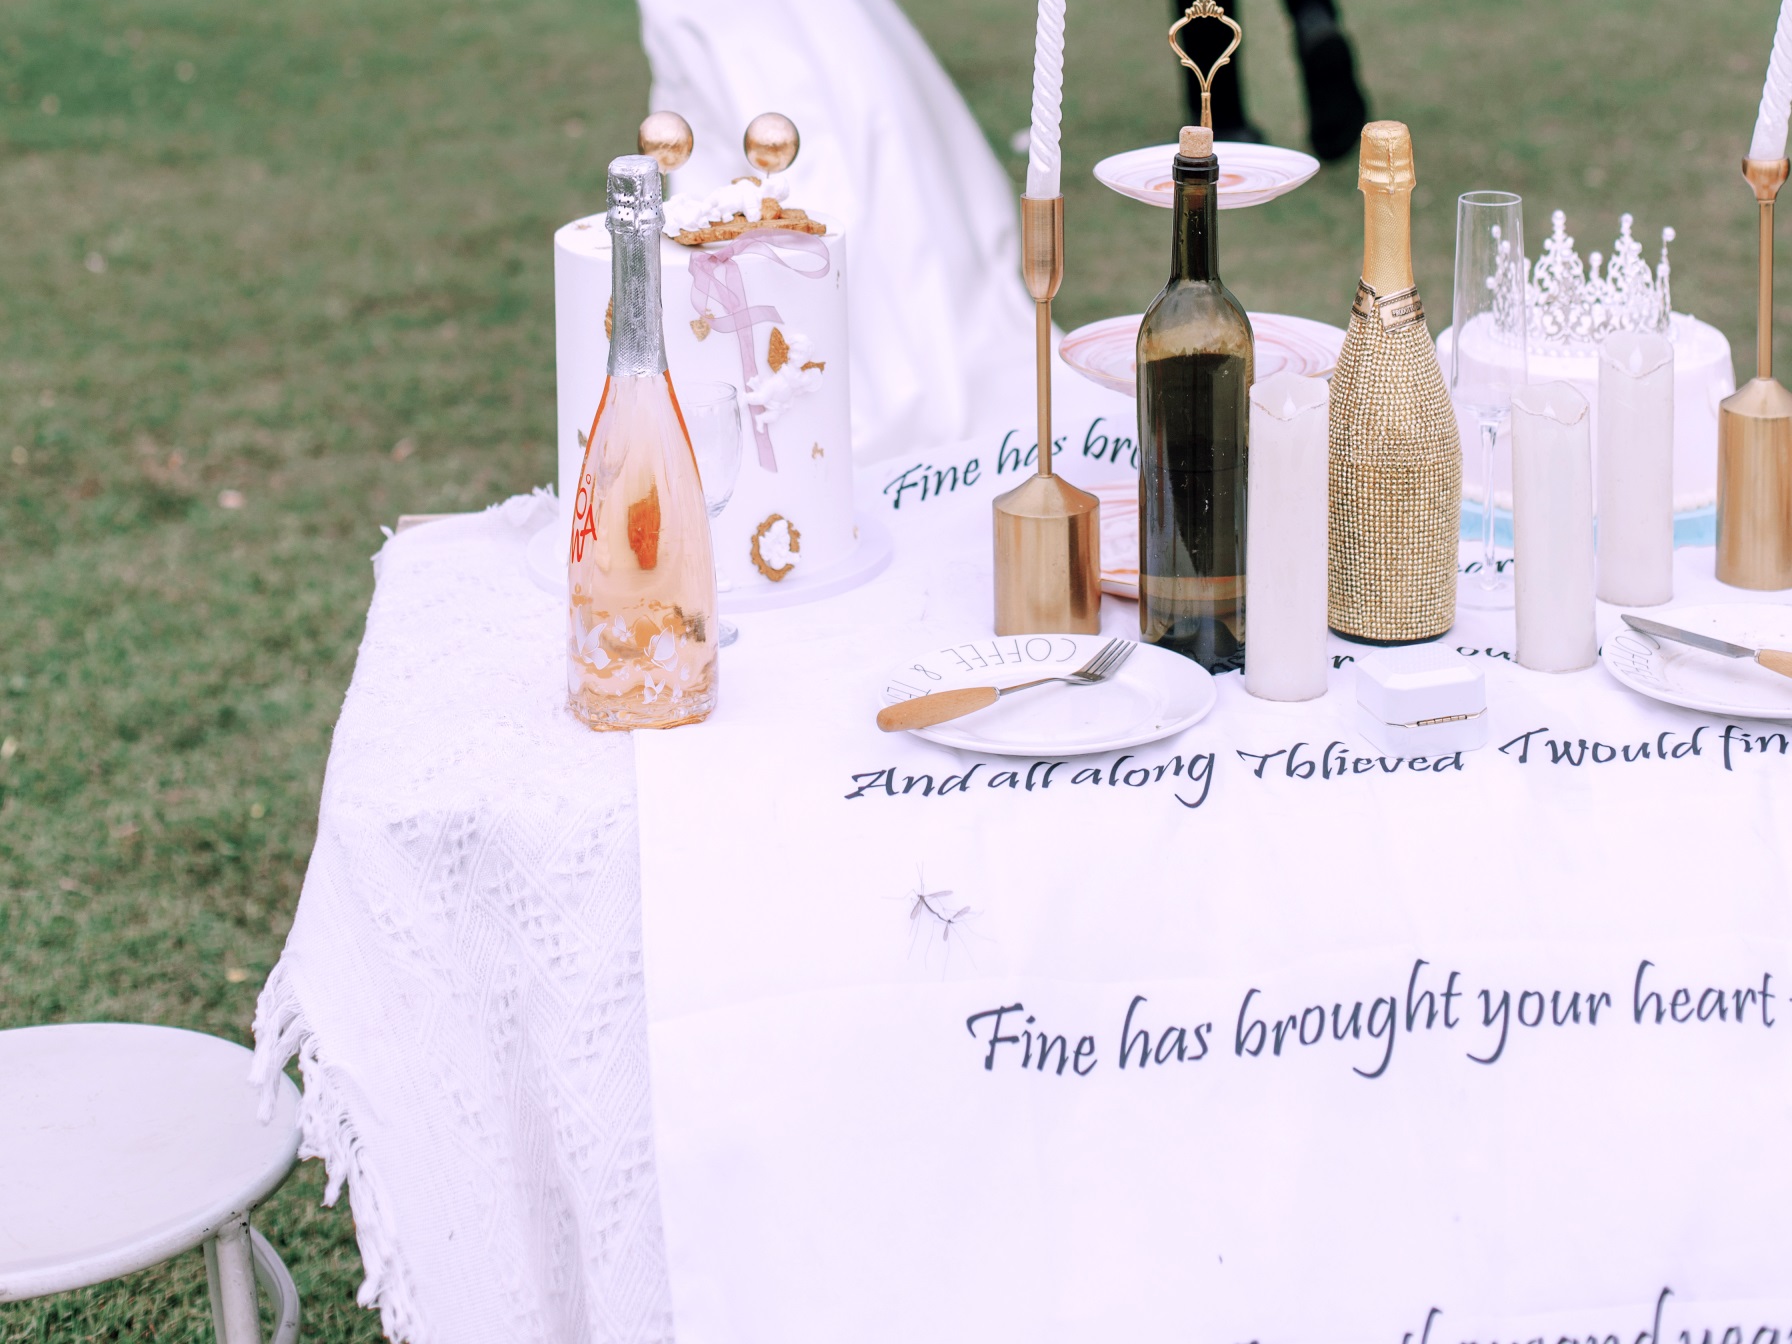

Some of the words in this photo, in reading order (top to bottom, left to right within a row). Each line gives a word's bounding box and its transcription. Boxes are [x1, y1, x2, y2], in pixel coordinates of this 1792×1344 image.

[882, 457, 982, 510] Fine
[909, 663, 942, 681] &
[940, 637, 1077, 672] COFFEE
[844, 763, 987, 800] And
[987, 761, 1069, 792] all
[1071, 752, 1216, 809] along
[966, 1002, 1098, 1077] Fine
[1119, 994, 1213, 1070] has
[1234, 958, 1463, 1080] brought
[1466, 988, 1612, 1066] your
[1633, 959, 1776, 1028] heart
